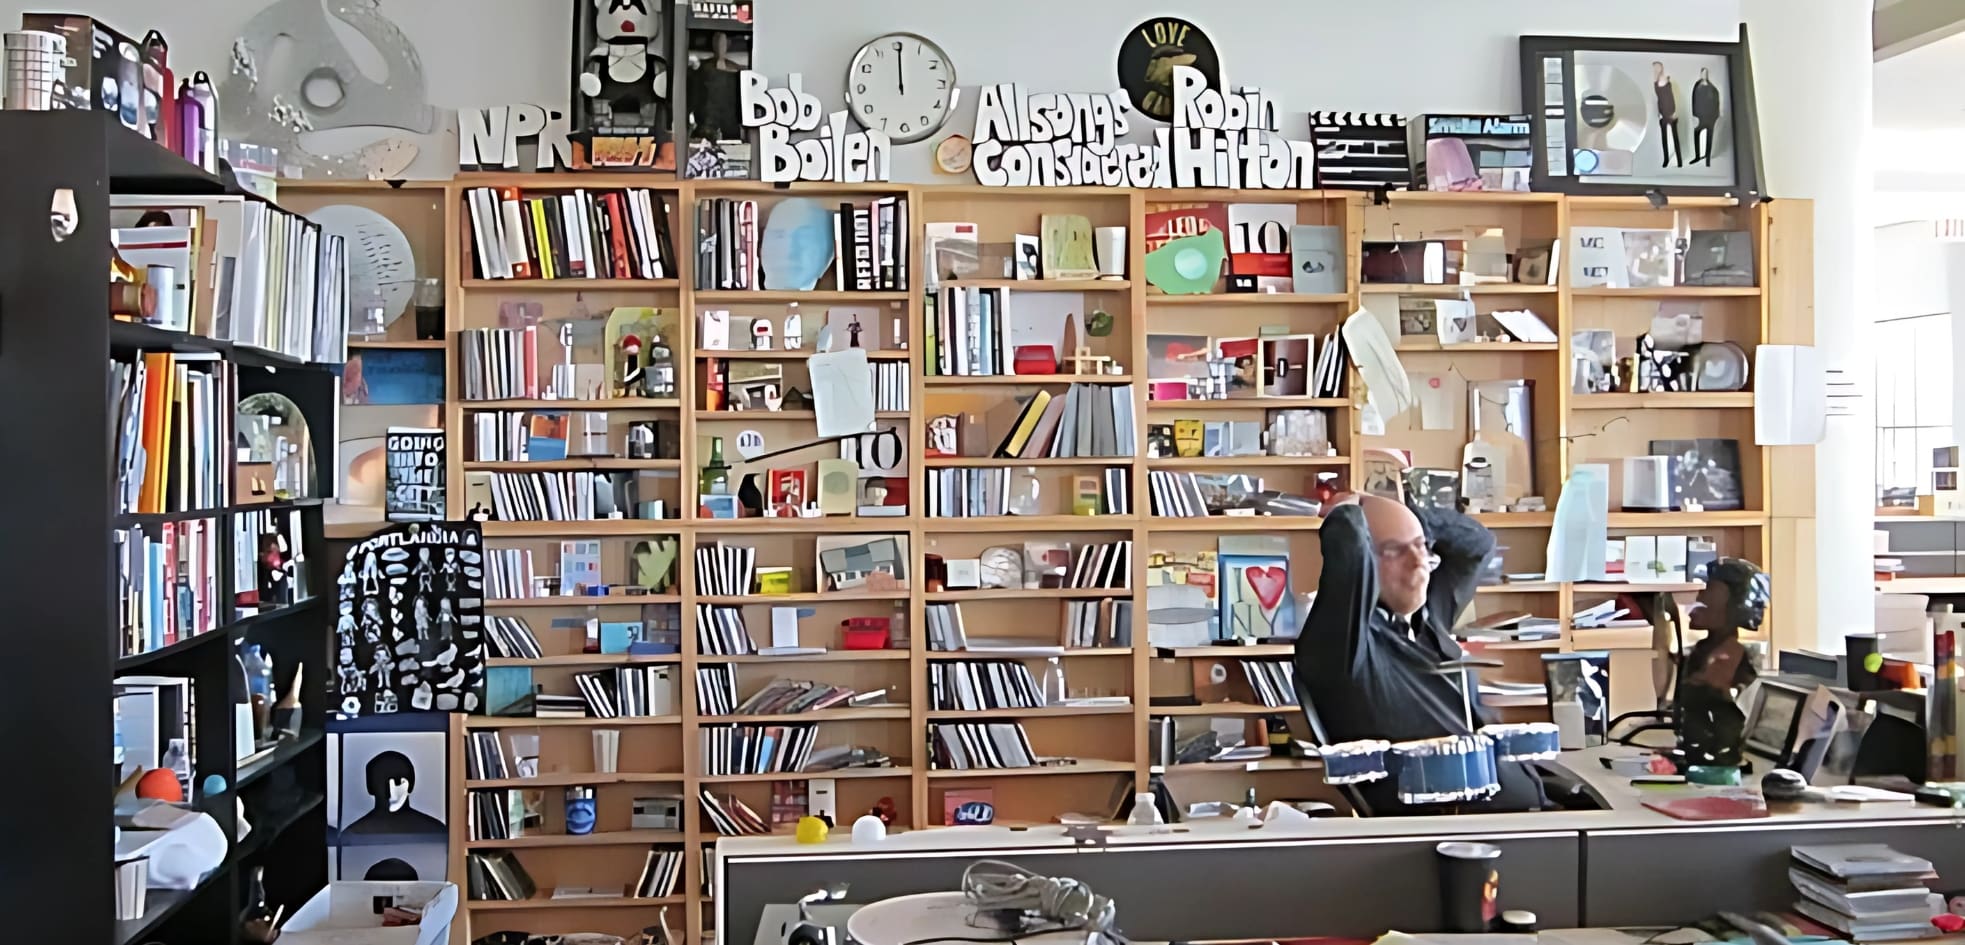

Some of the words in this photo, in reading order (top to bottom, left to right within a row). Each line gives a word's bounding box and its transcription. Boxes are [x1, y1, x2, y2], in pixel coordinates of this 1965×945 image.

[1141, 21, 1192, 48] LOVE
[740, 70, 822, 131] Bob
[1173, 65, 1280, 132] Robin
[458, 104, 573, 169] NPR
[760, 110, 891, 182] Boilen
[1173, 127, 1315, 189] Hilton
[1234, 220, 1288, 254] 10
